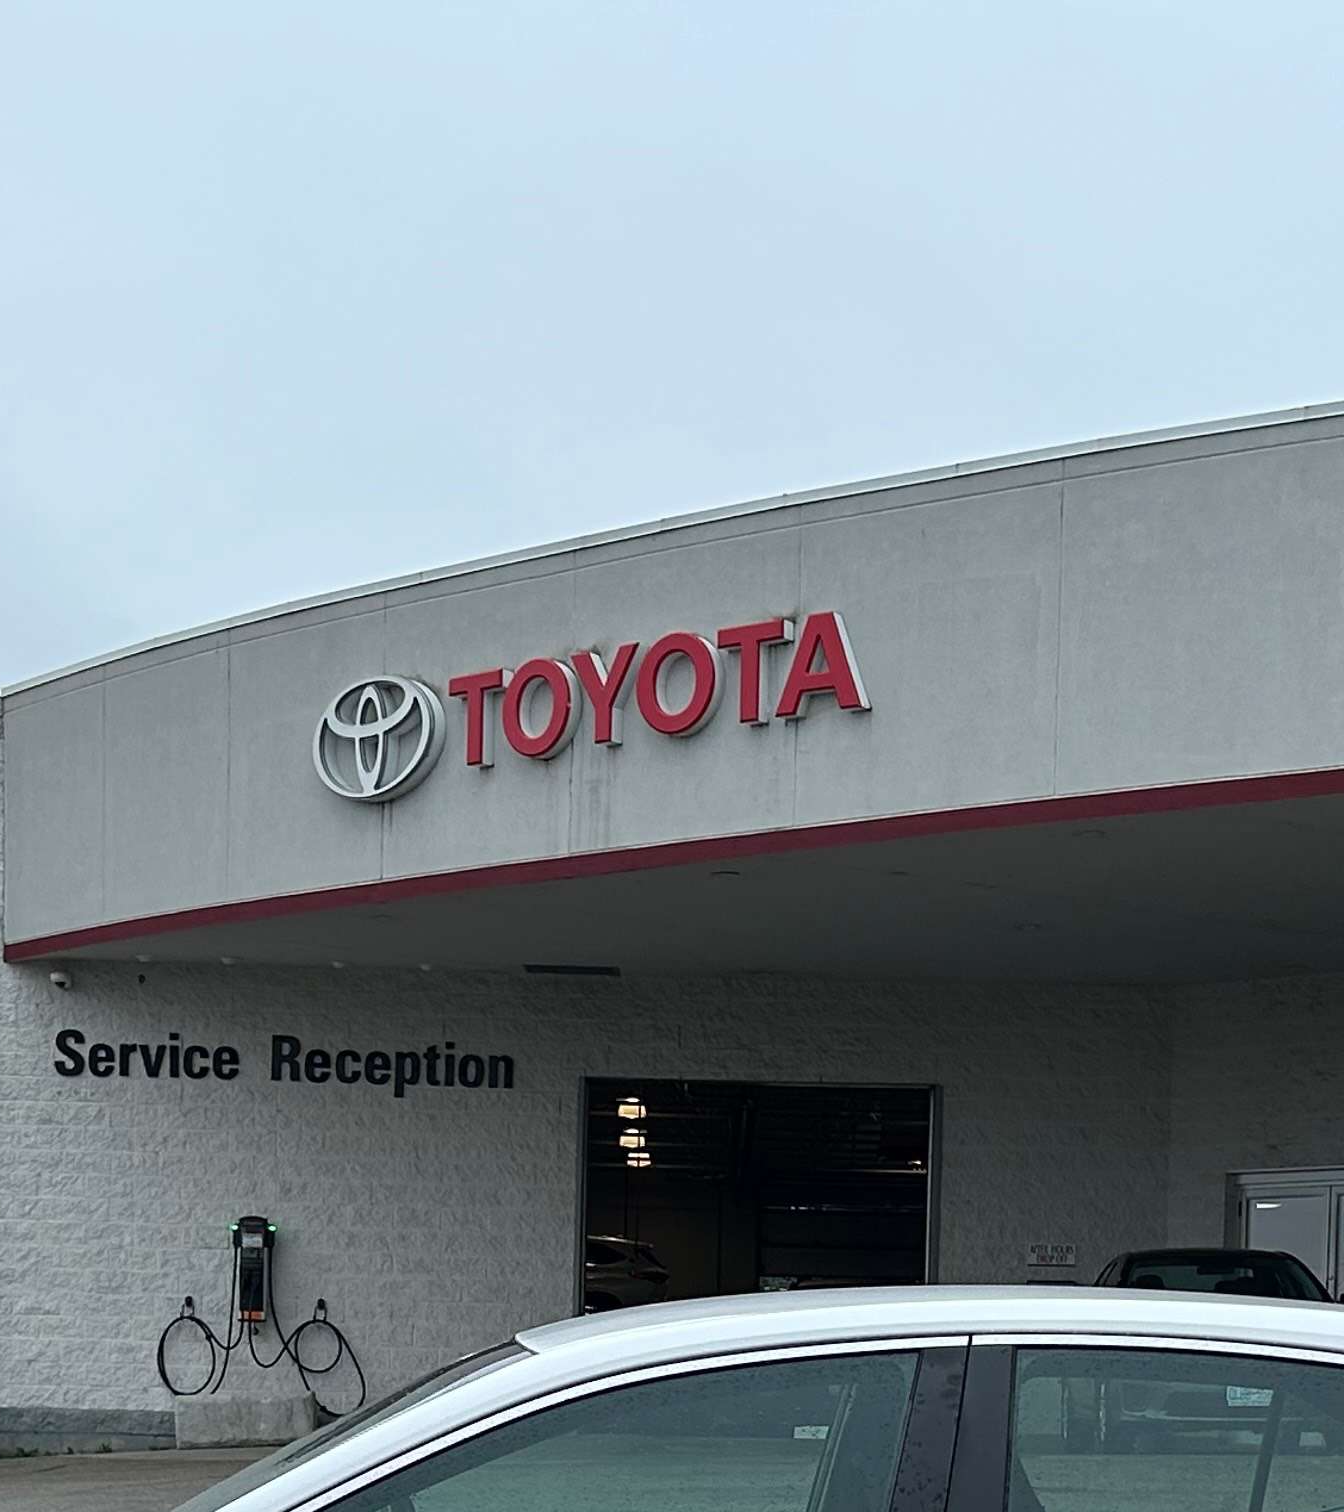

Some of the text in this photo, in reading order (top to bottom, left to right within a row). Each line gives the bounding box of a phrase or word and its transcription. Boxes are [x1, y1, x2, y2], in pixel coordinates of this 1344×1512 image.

[449, 611, 868, 768] TOYOTA
[54, 1029, 514, 1097] Service Reception
